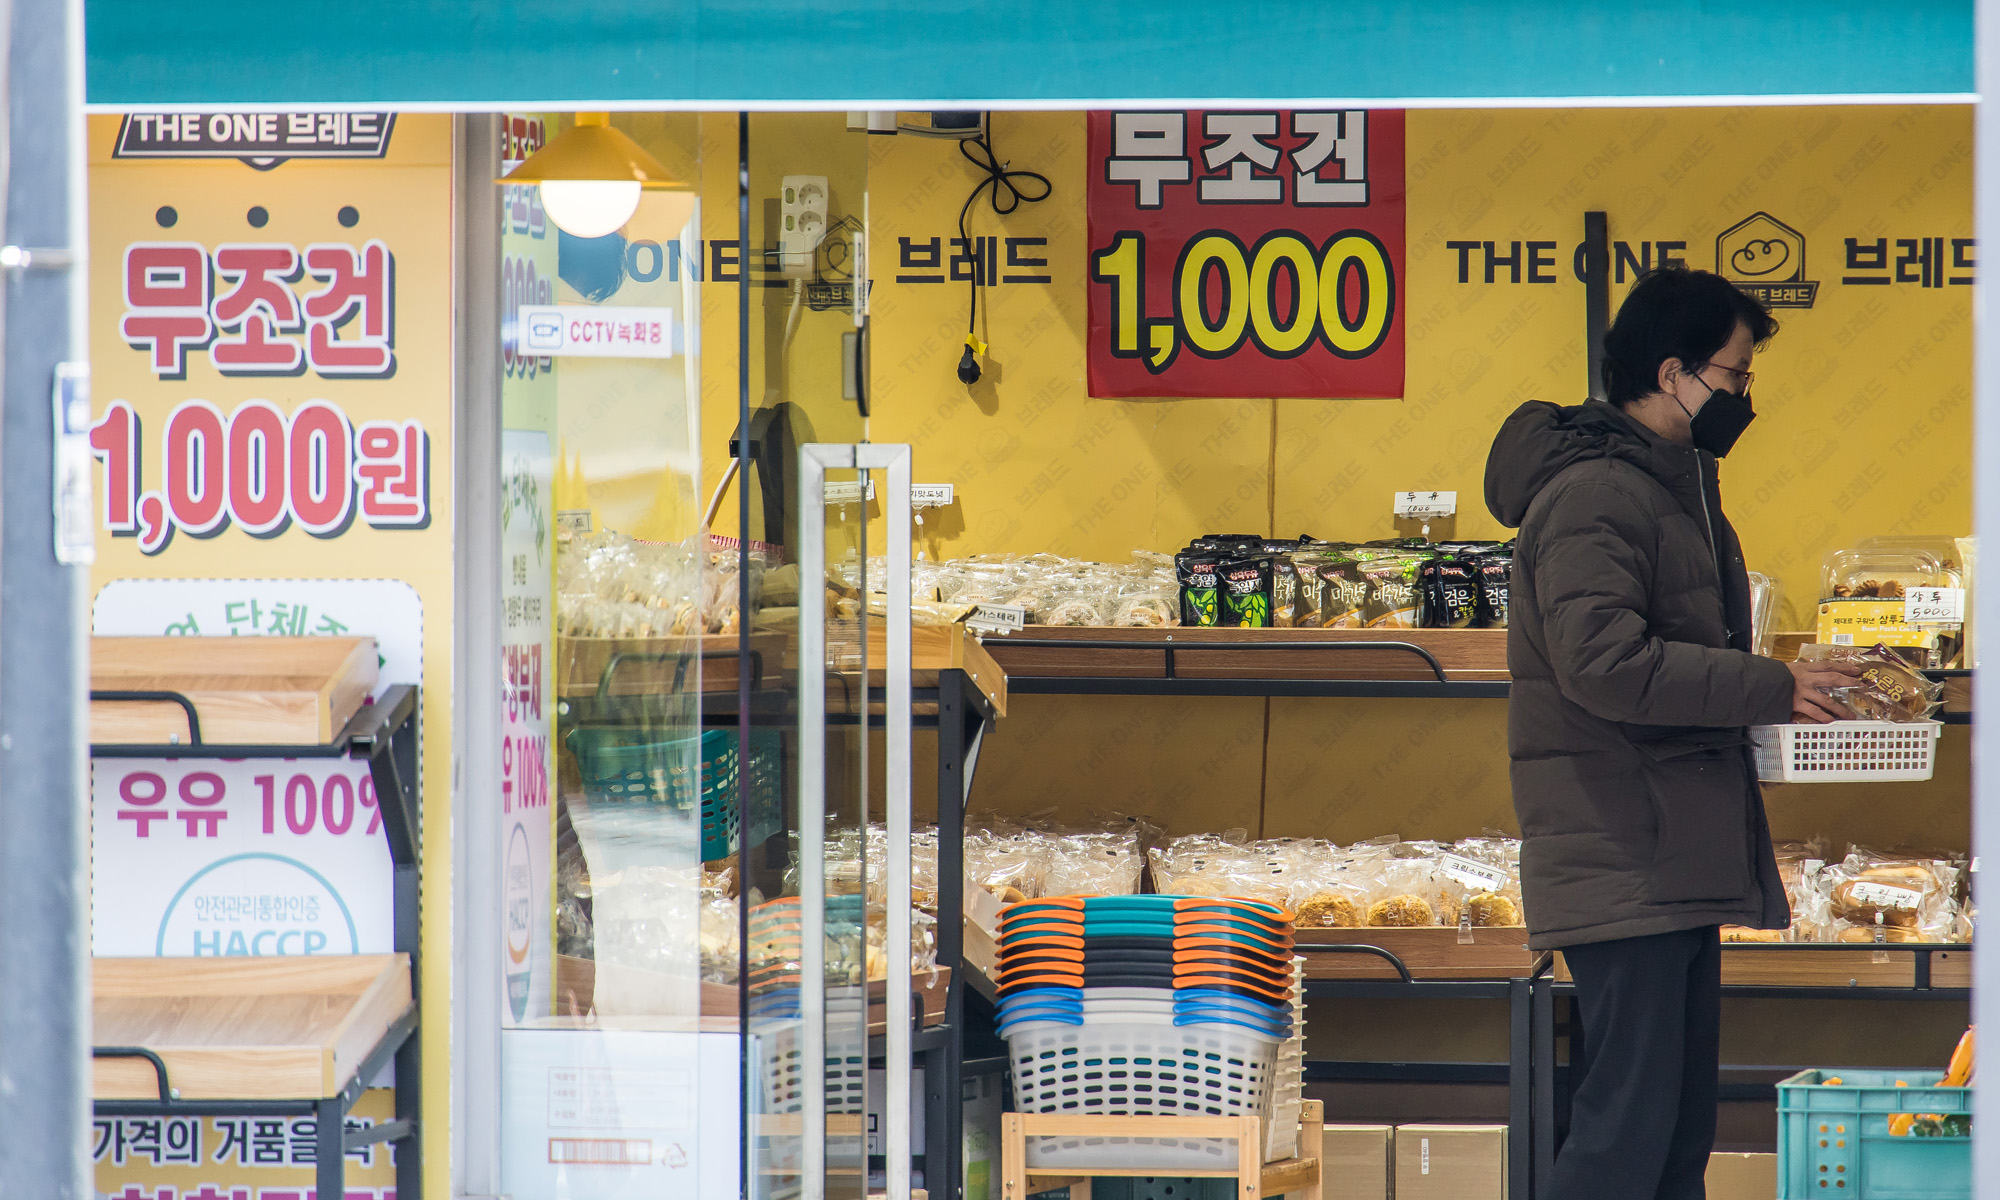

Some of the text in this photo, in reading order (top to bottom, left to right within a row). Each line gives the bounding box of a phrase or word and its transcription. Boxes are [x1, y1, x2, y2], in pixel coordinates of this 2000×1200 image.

[134, 112, 380, 145] THE ONE 브레드
[1108, 111, 1367, 206] 무조건
[895, 237, 1052, 286] 브레드
[1447, 240, 1557, 284] THE
[1842, 237, 1978, 288] 브레드
[121, 239, 393, 378] 무조건
[1098, 234, 1391, 370] 1,000
[1770, 289, 1811, 303] 브레드
[570, 320, 662, 344] CCTV녹화중
[90, 400, 429, 553] 1,000원
[117, 771, 228, 837] 우유
[194, 895, 321, 922] 안전관리통합인증
[193, 929, 328, 957] HACCP
[93, 1119, 199, 1164] 가격의
[216, 1119, 318, 1164] 거품을
